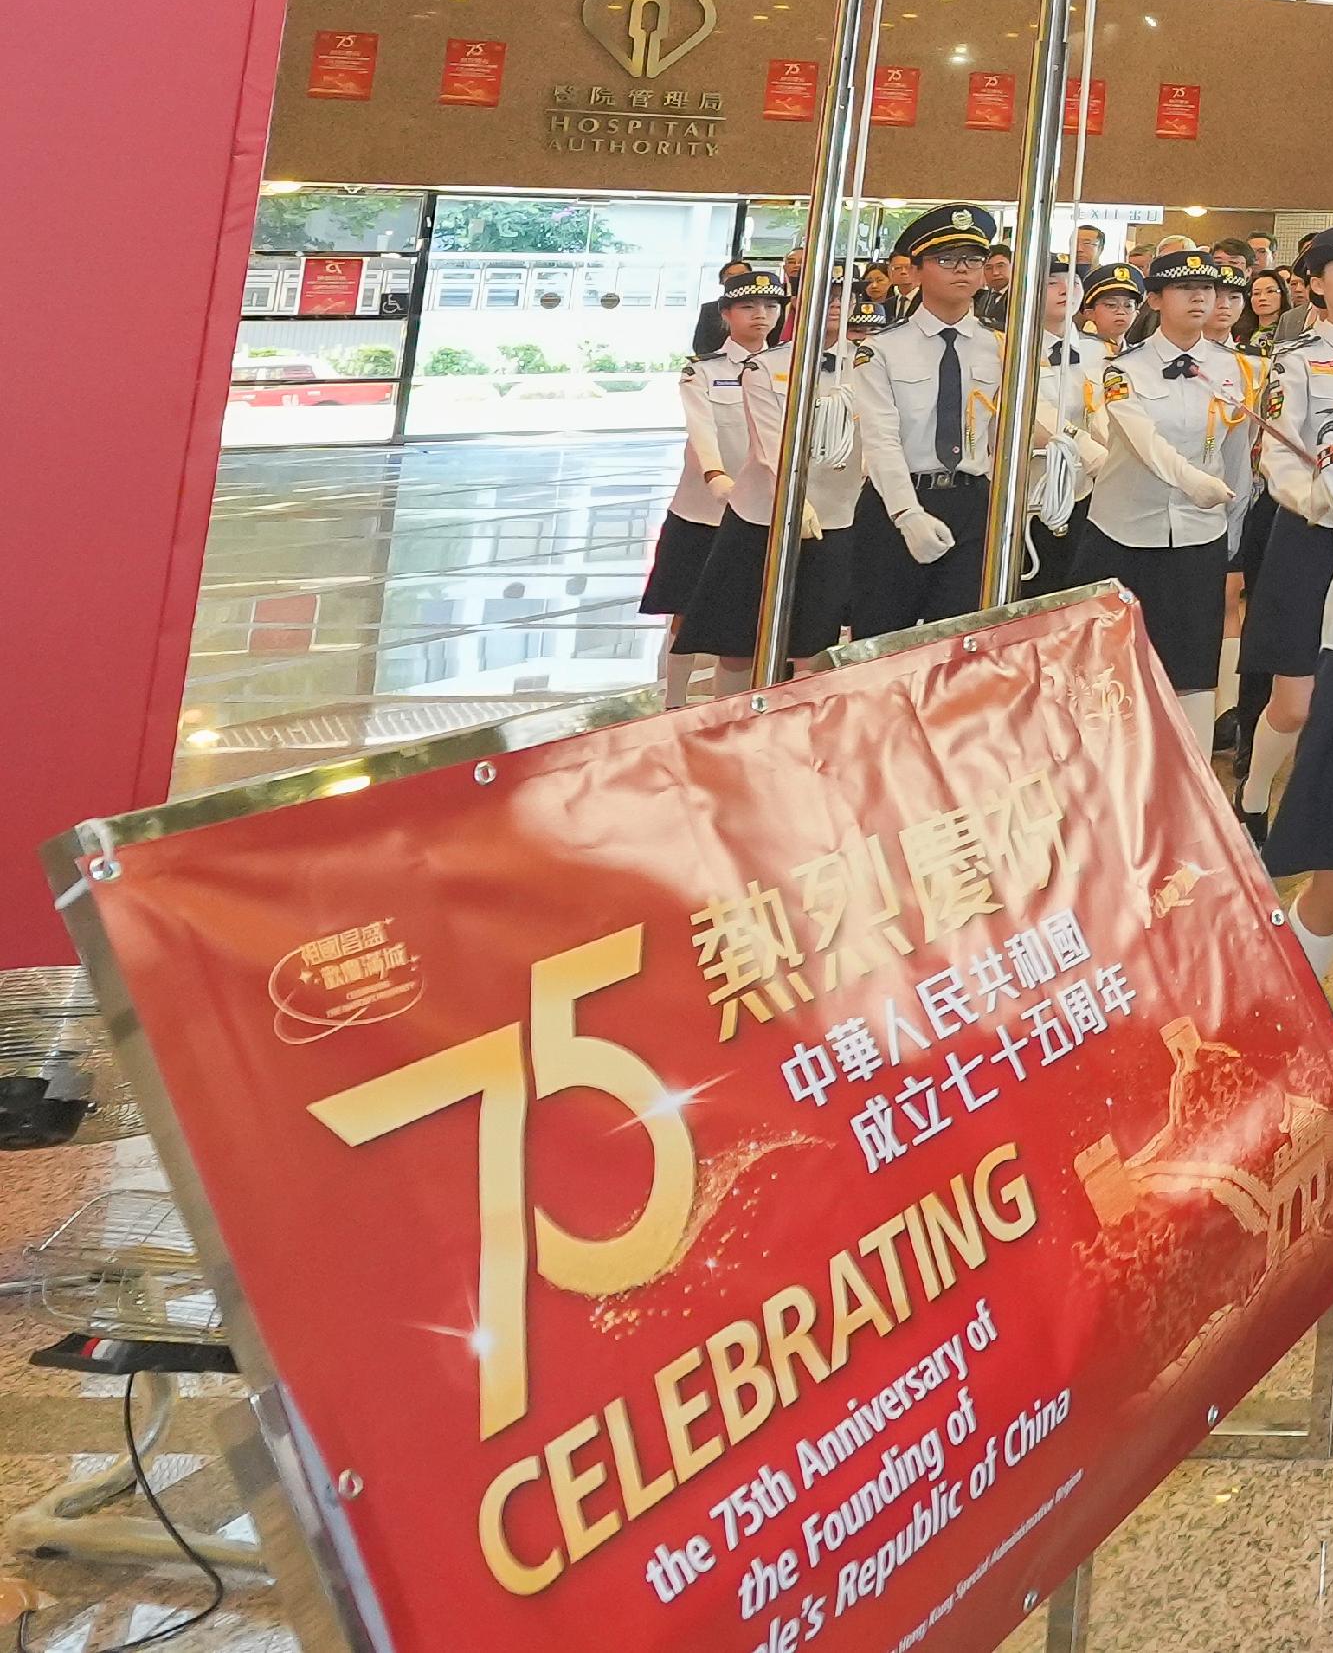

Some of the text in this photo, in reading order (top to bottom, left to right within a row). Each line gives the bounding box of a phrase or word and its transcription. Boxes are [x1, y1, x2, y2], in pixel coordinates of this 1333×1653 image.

[336, 34, 357, 48] 75
[465, 43, 485, 56] 75
[783, 63, 800, 75] 75
[887, 69, 903, 82] 75
[983, 76, 999, 88] 75
[1172, 87, 1186, 98] 75
[549, 138, 719, 157] AUTHORITY
[690, 768, 1081, 1043] 熱烈慶祝
[779, 908, 1092, 1108] 中華人民共和國
[849, 962, 1138, 1174] 成立七十五周年
[305, 922, 696, 1442] 75
[478, 1142, 1038, 1597] CELEBRATING
[645, 1298, 999, 1604] the 75th Anniversary of
[737, 1384, 979, 1621] the Founding of
[834, 1479, 964, 1618] Republic
[969, 1435, 998, 1502] of
[1003, 1387, 1072, 1468] China
